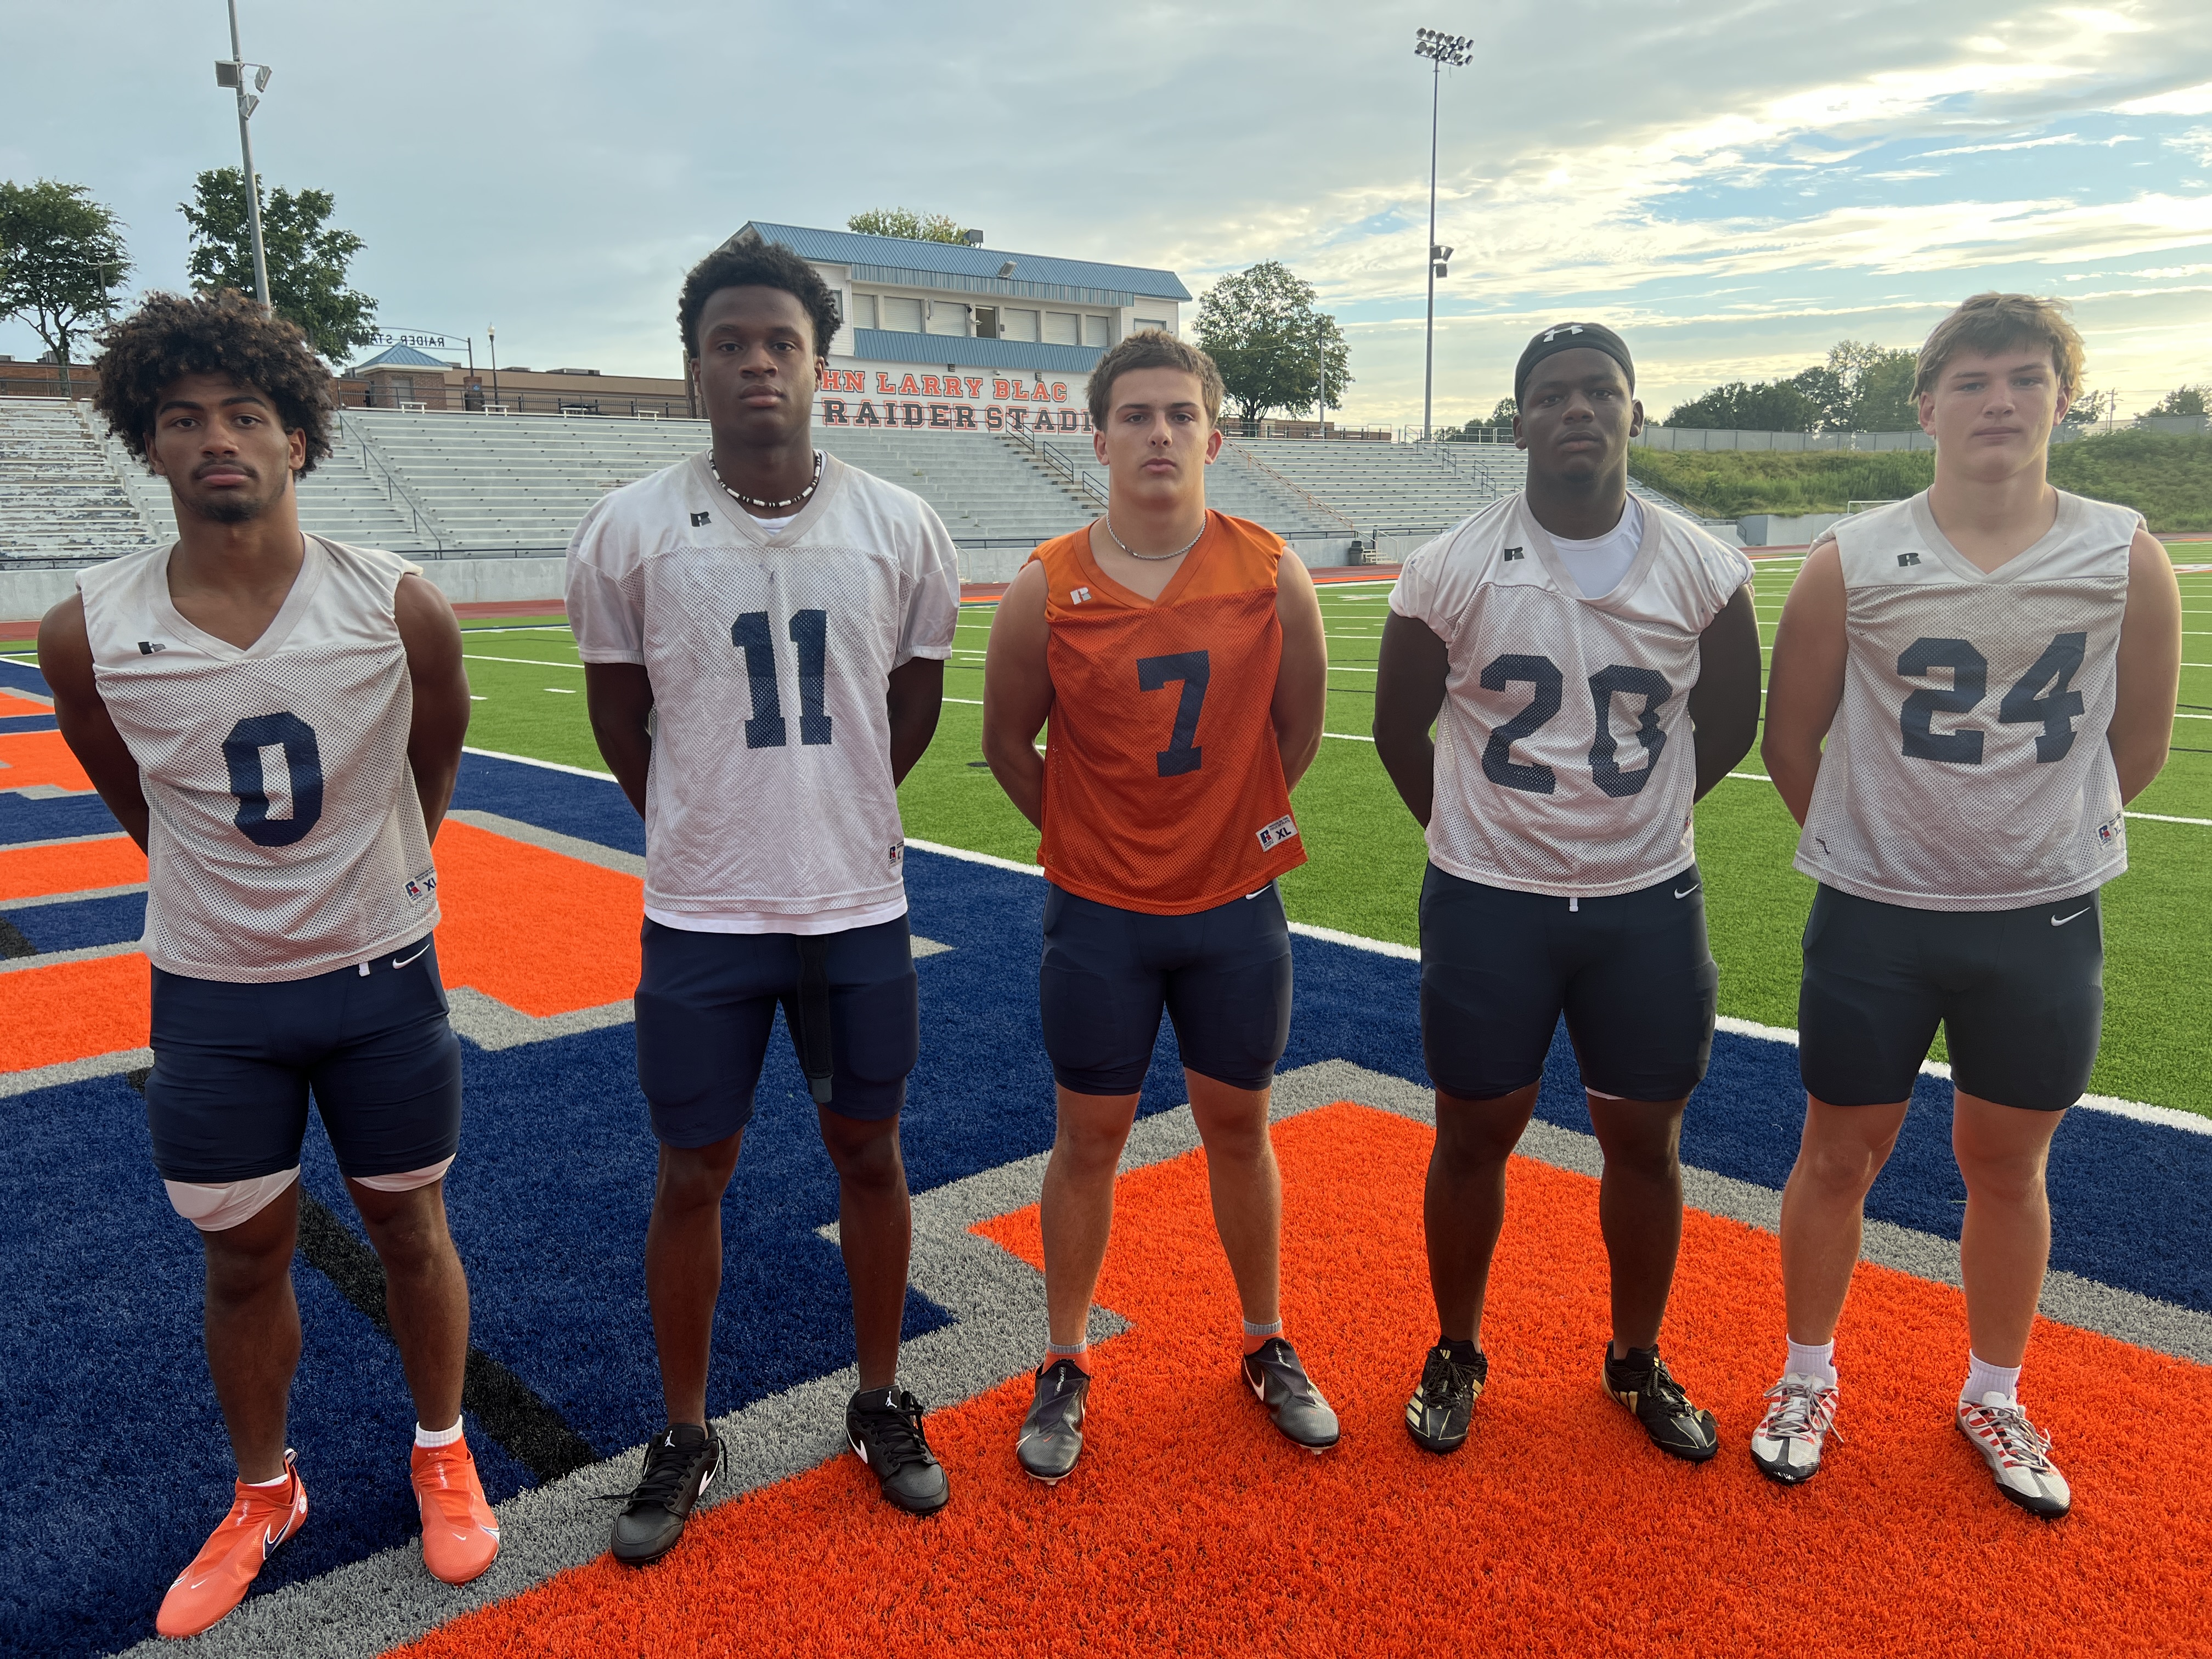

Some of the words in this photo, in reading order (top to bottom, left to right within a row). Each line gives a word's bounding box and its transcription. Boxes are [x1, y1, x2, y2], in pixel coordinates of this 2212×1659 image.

[821, 369, 865, 393] HN
[876, 372, 983, 399] LARRY
[993, 379, 1066, 402] BLAC
[822, 398, 978, 430] RAIDER
[985, 405, 1094, 434] STADI
[730, 609, 832, 749] 11
[1136, 650, 1210, 778] 7
[1480, 654, 1673, 798] 20
[1897, 631, 2087, 765] 24
[222, 712, 323, 847] 0
[1275, 827, 1291, 840] XL
